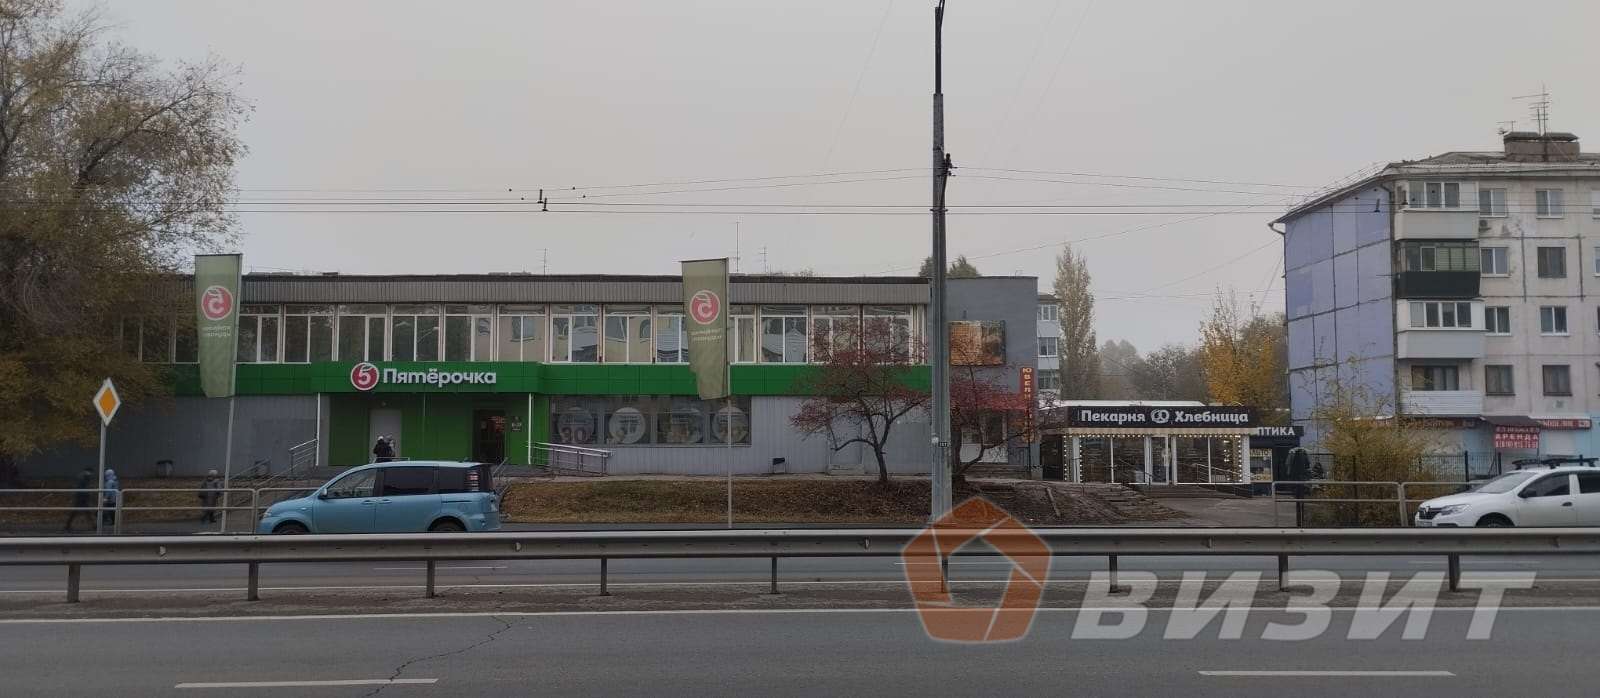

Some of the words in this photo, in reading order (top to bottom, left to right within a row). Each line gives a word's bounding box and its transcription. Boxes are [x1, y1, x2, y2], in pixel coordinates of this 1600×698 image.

[383, 368, 497, 388] Пятёрочка
[1081, 409, 1146, 425] Пекарня
[1174, 409, 1249, 425] Хлебница
[1256, 426, 1296, 436] ПТИКА
